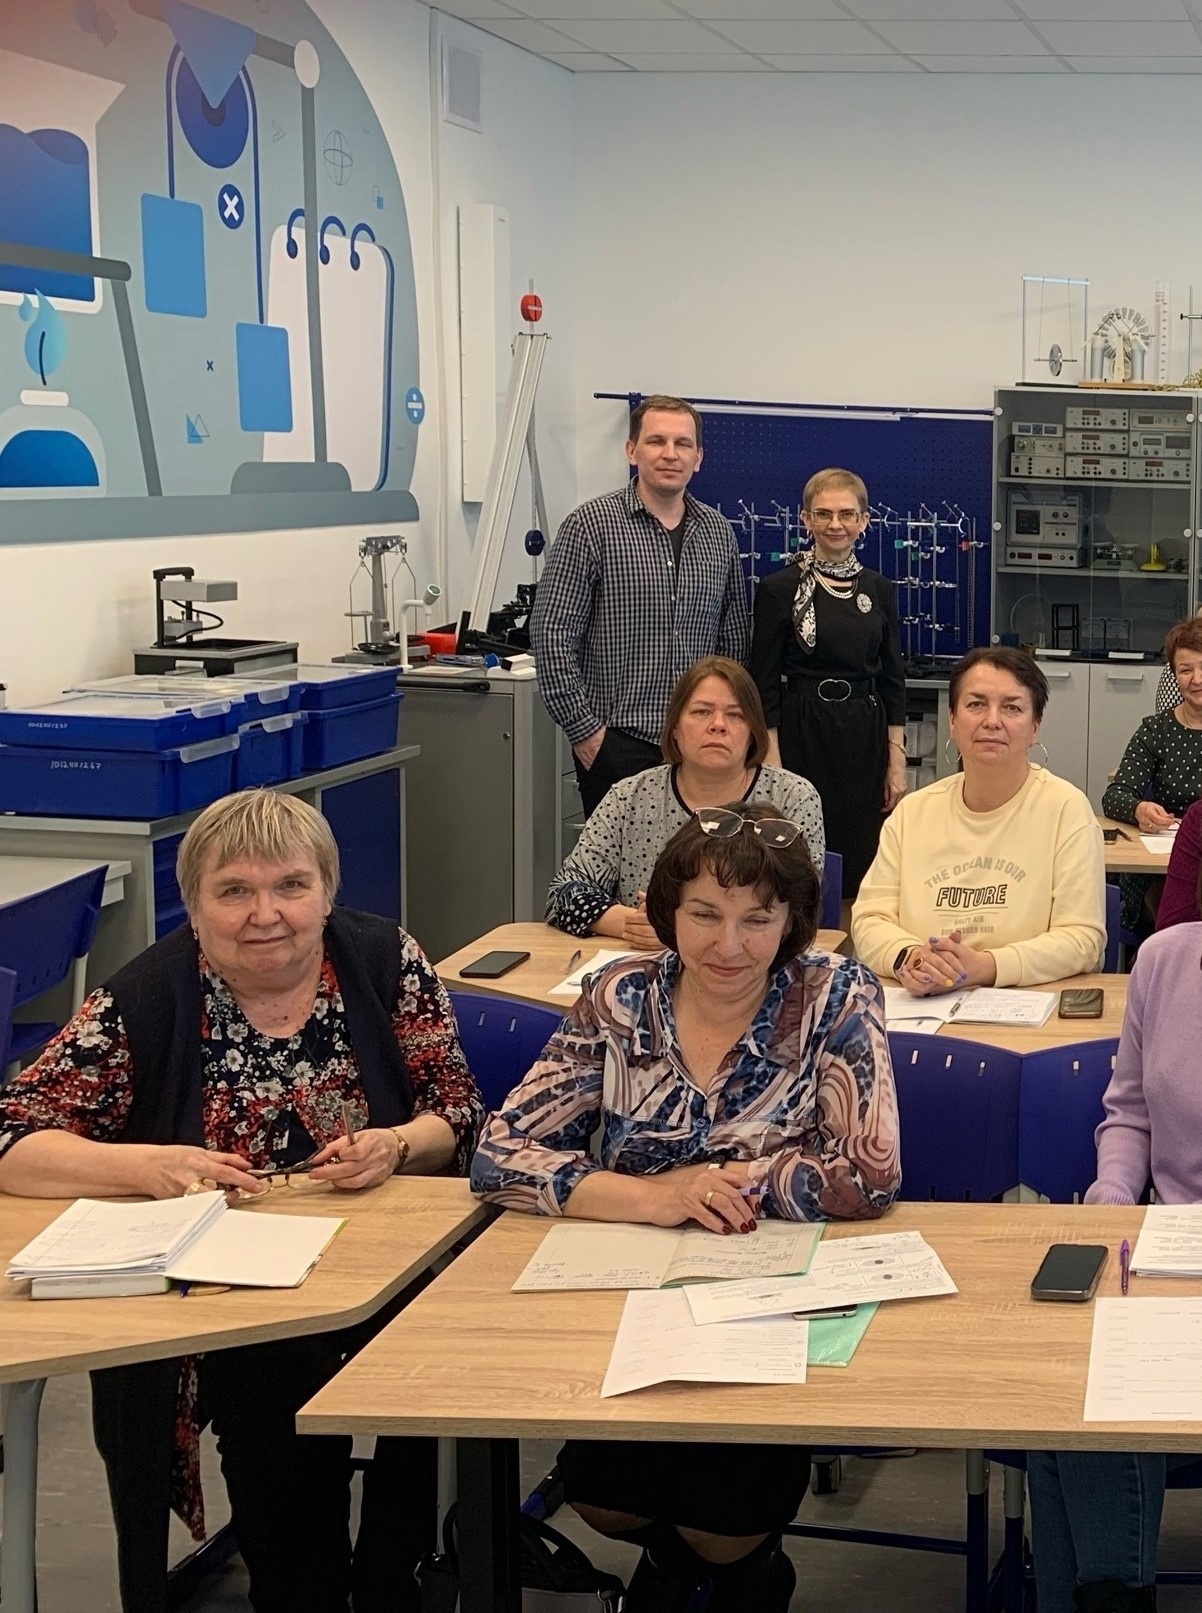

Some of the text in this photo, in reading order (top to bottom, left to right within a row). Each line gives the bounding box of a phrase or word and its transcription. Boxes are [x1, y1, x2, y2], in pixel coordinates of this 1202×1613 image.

[924, 856, 1027, 888] THE OCEAN IS OUR
[936, 884, 1008, 908] FUTURE
